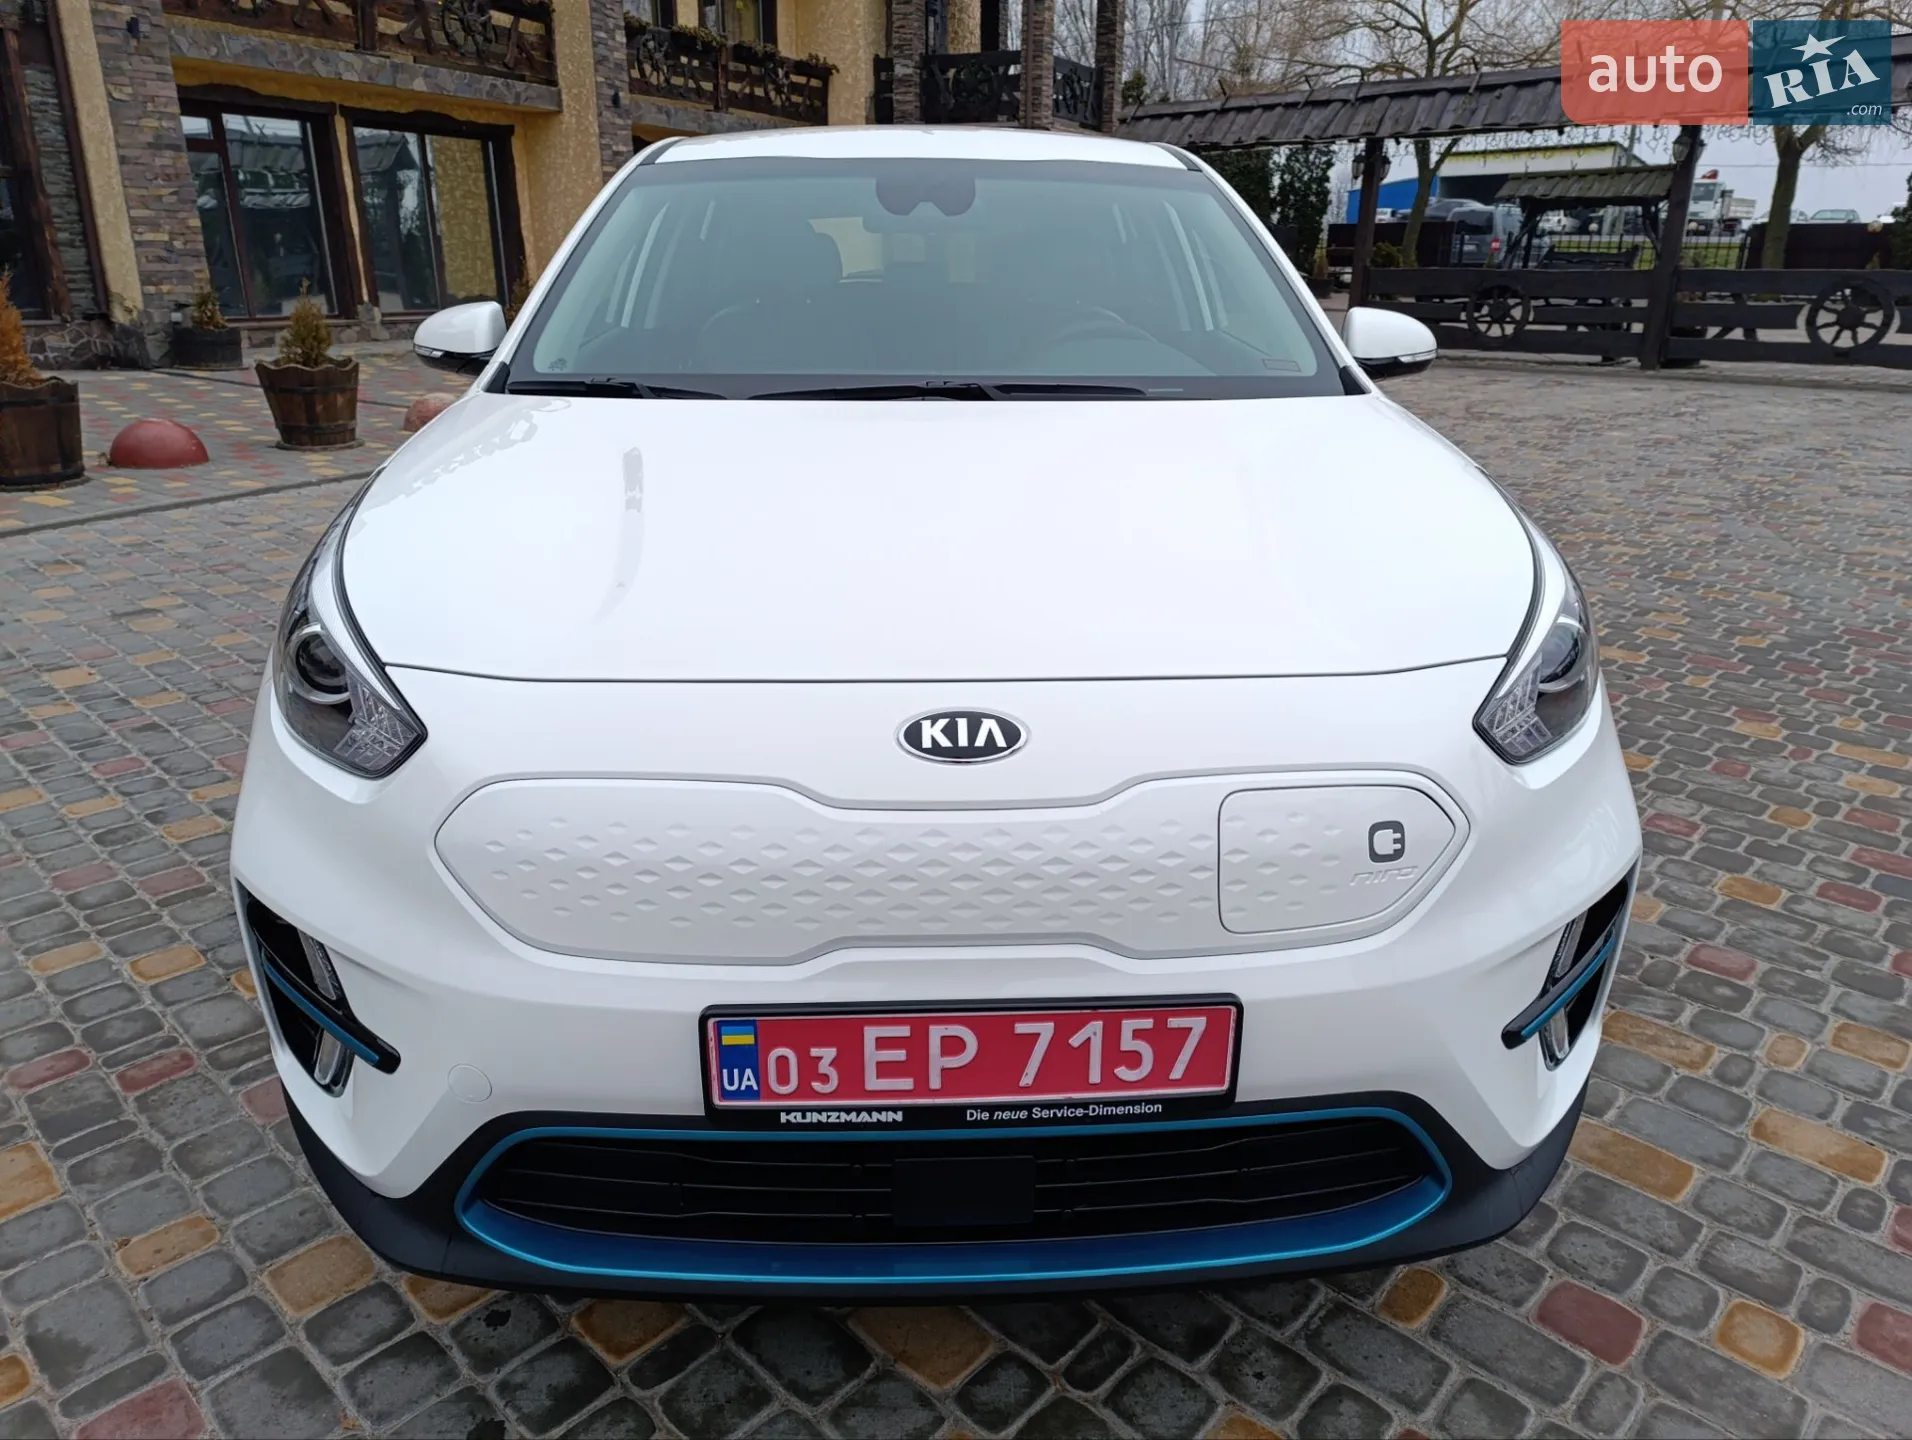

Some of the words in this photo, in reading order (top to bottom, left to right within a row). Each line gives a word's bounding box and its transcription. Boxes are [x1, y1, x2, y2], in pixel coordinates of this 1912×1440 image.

[919, 717, 1008, 749] KIA
[767, 1047, 839, 1096] 03
[863, 1023, 979, 1092] EP
[1013, 1016, 1207, 1088] 7157
[722, 1068, 759, 1091] UA
[780, 1110, 904, 1124] KUNZMANN
[966, 1109, 990, 1121] Die
[993, 1109, 1028, 1121] neue
[1031, 1102, 1162, 1119] Service-Dimension
